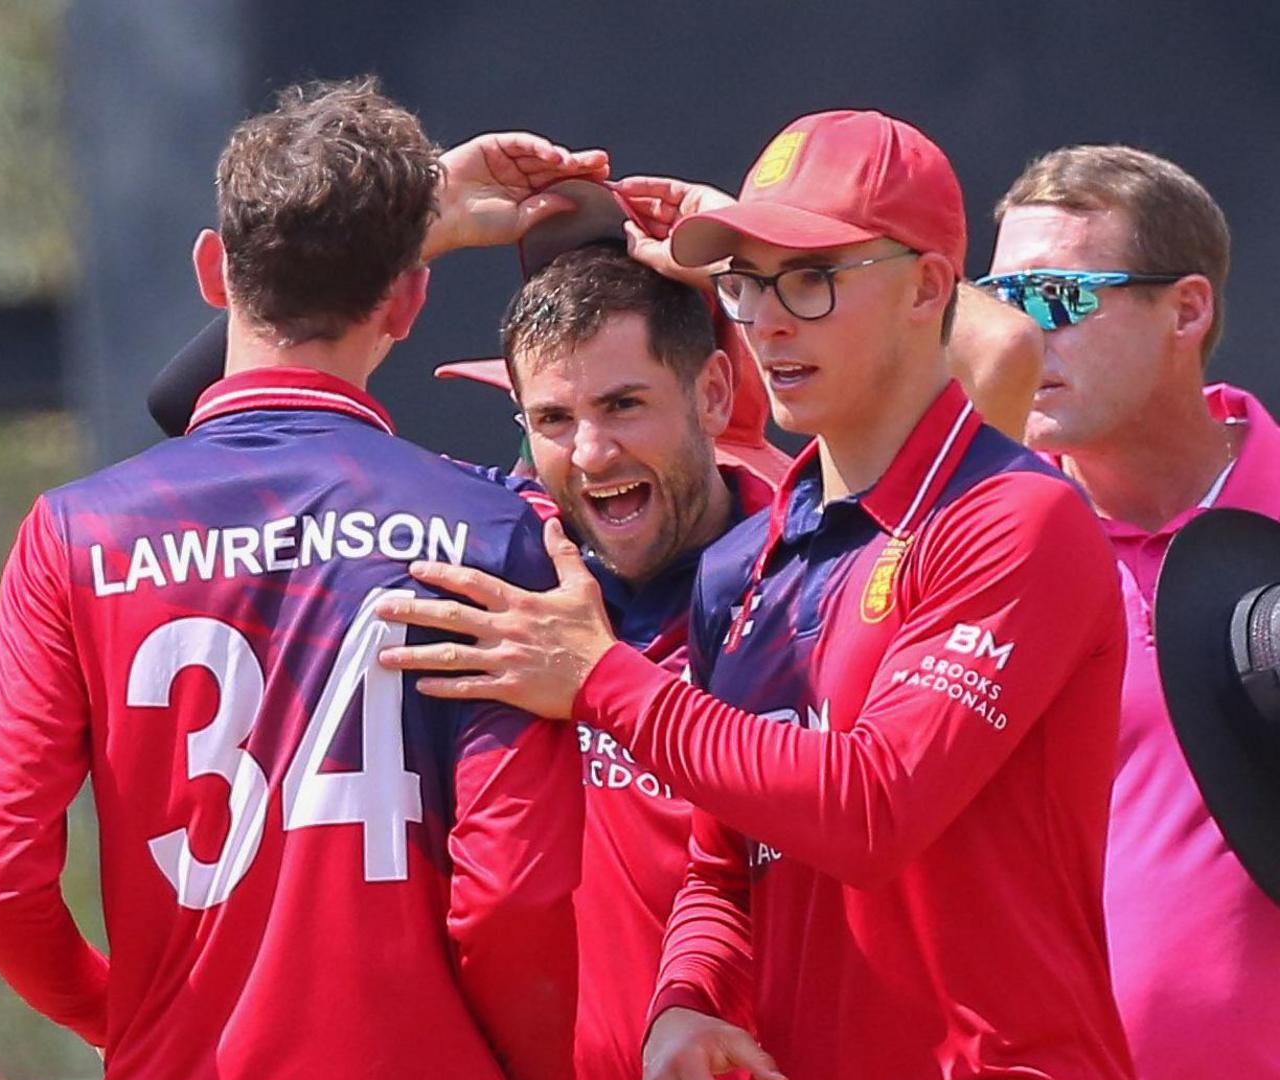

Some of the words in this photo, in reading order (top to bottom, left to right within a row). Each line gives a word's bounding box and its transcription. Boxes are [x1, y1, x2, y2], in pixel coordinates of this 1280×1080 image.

[90, 511, 469, 597] LAWRENSON
[920, 655, 1002, 701] BROOKS
[944, 622, 1016, 671] BM
[891, 668, 1008, 731] MACDONALD
[126, 588, 423, 910] 34
